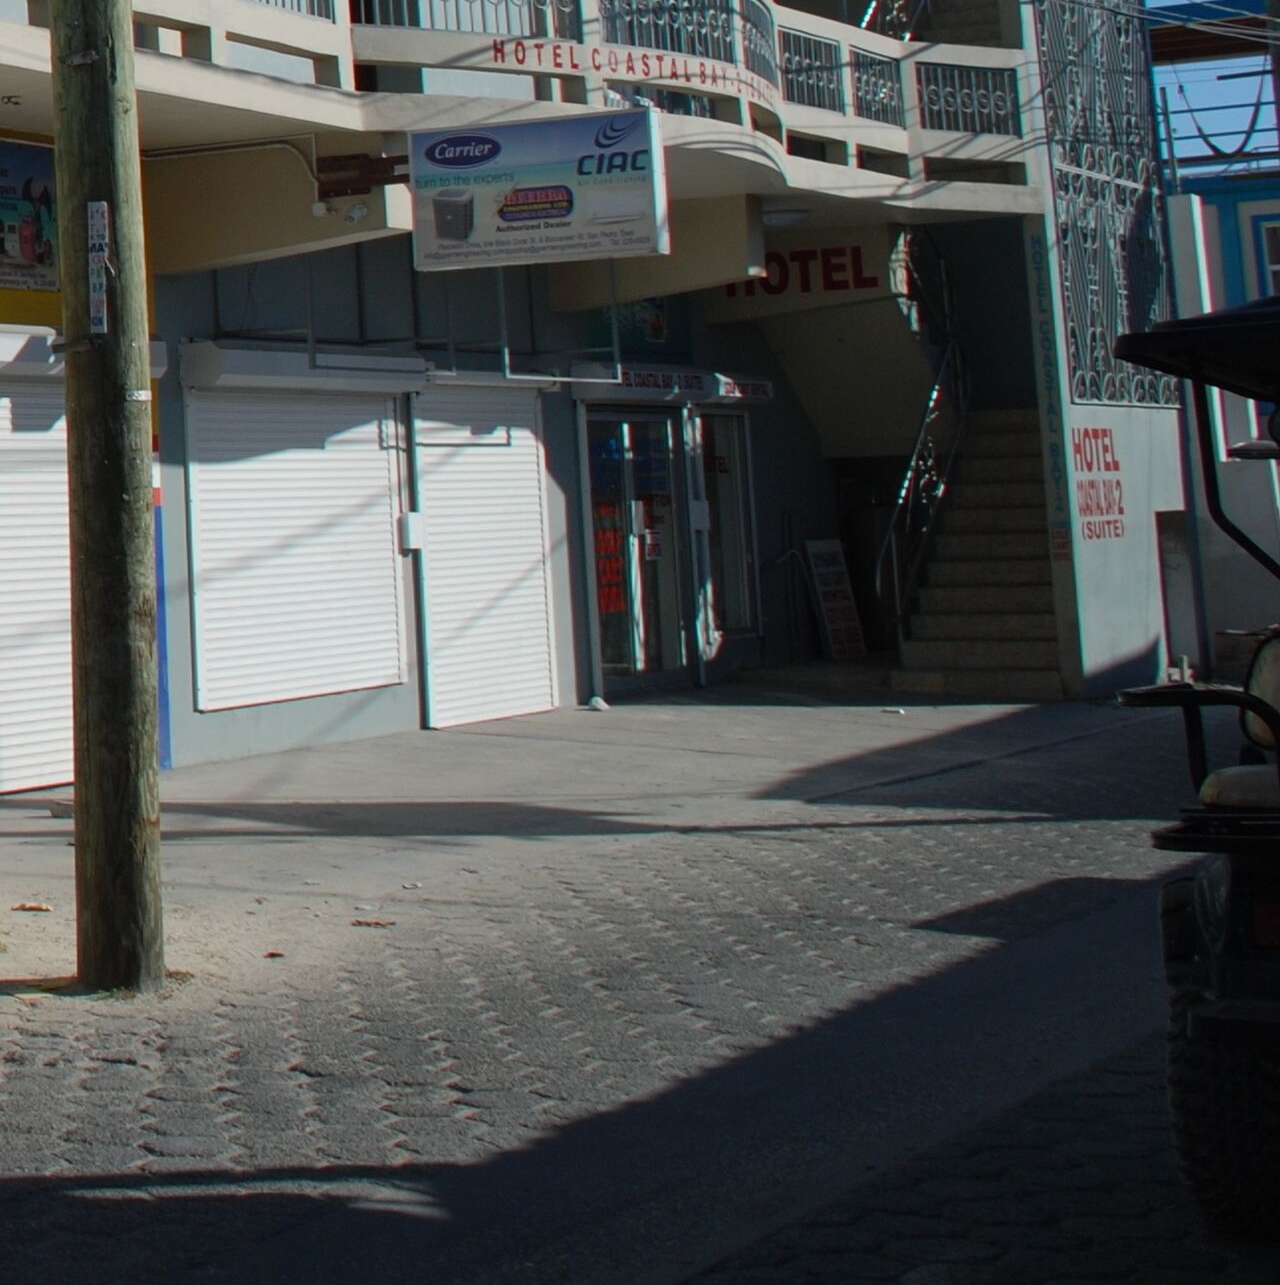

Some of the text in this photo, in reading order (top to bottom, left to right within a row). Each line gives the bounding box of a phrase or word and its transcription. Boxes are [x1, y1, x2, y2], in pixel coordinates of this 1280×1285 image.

[492, 39, 579, 70] HOTEL
[592, 49, 691, 82] COASTAL
[435, 141, 492, 159] Carrier
[576, 149, 649, 176] CIAC
[439, 176, 451, 187] to
[453, 175, 470, 186] the
[474, 171, 515, 186] experts
[496, 220, 572, 233] Authorized Dealer
[1071, 427, 1121, 473] HOTEL
[1081, 519, 1125, 540] (SUITE)
